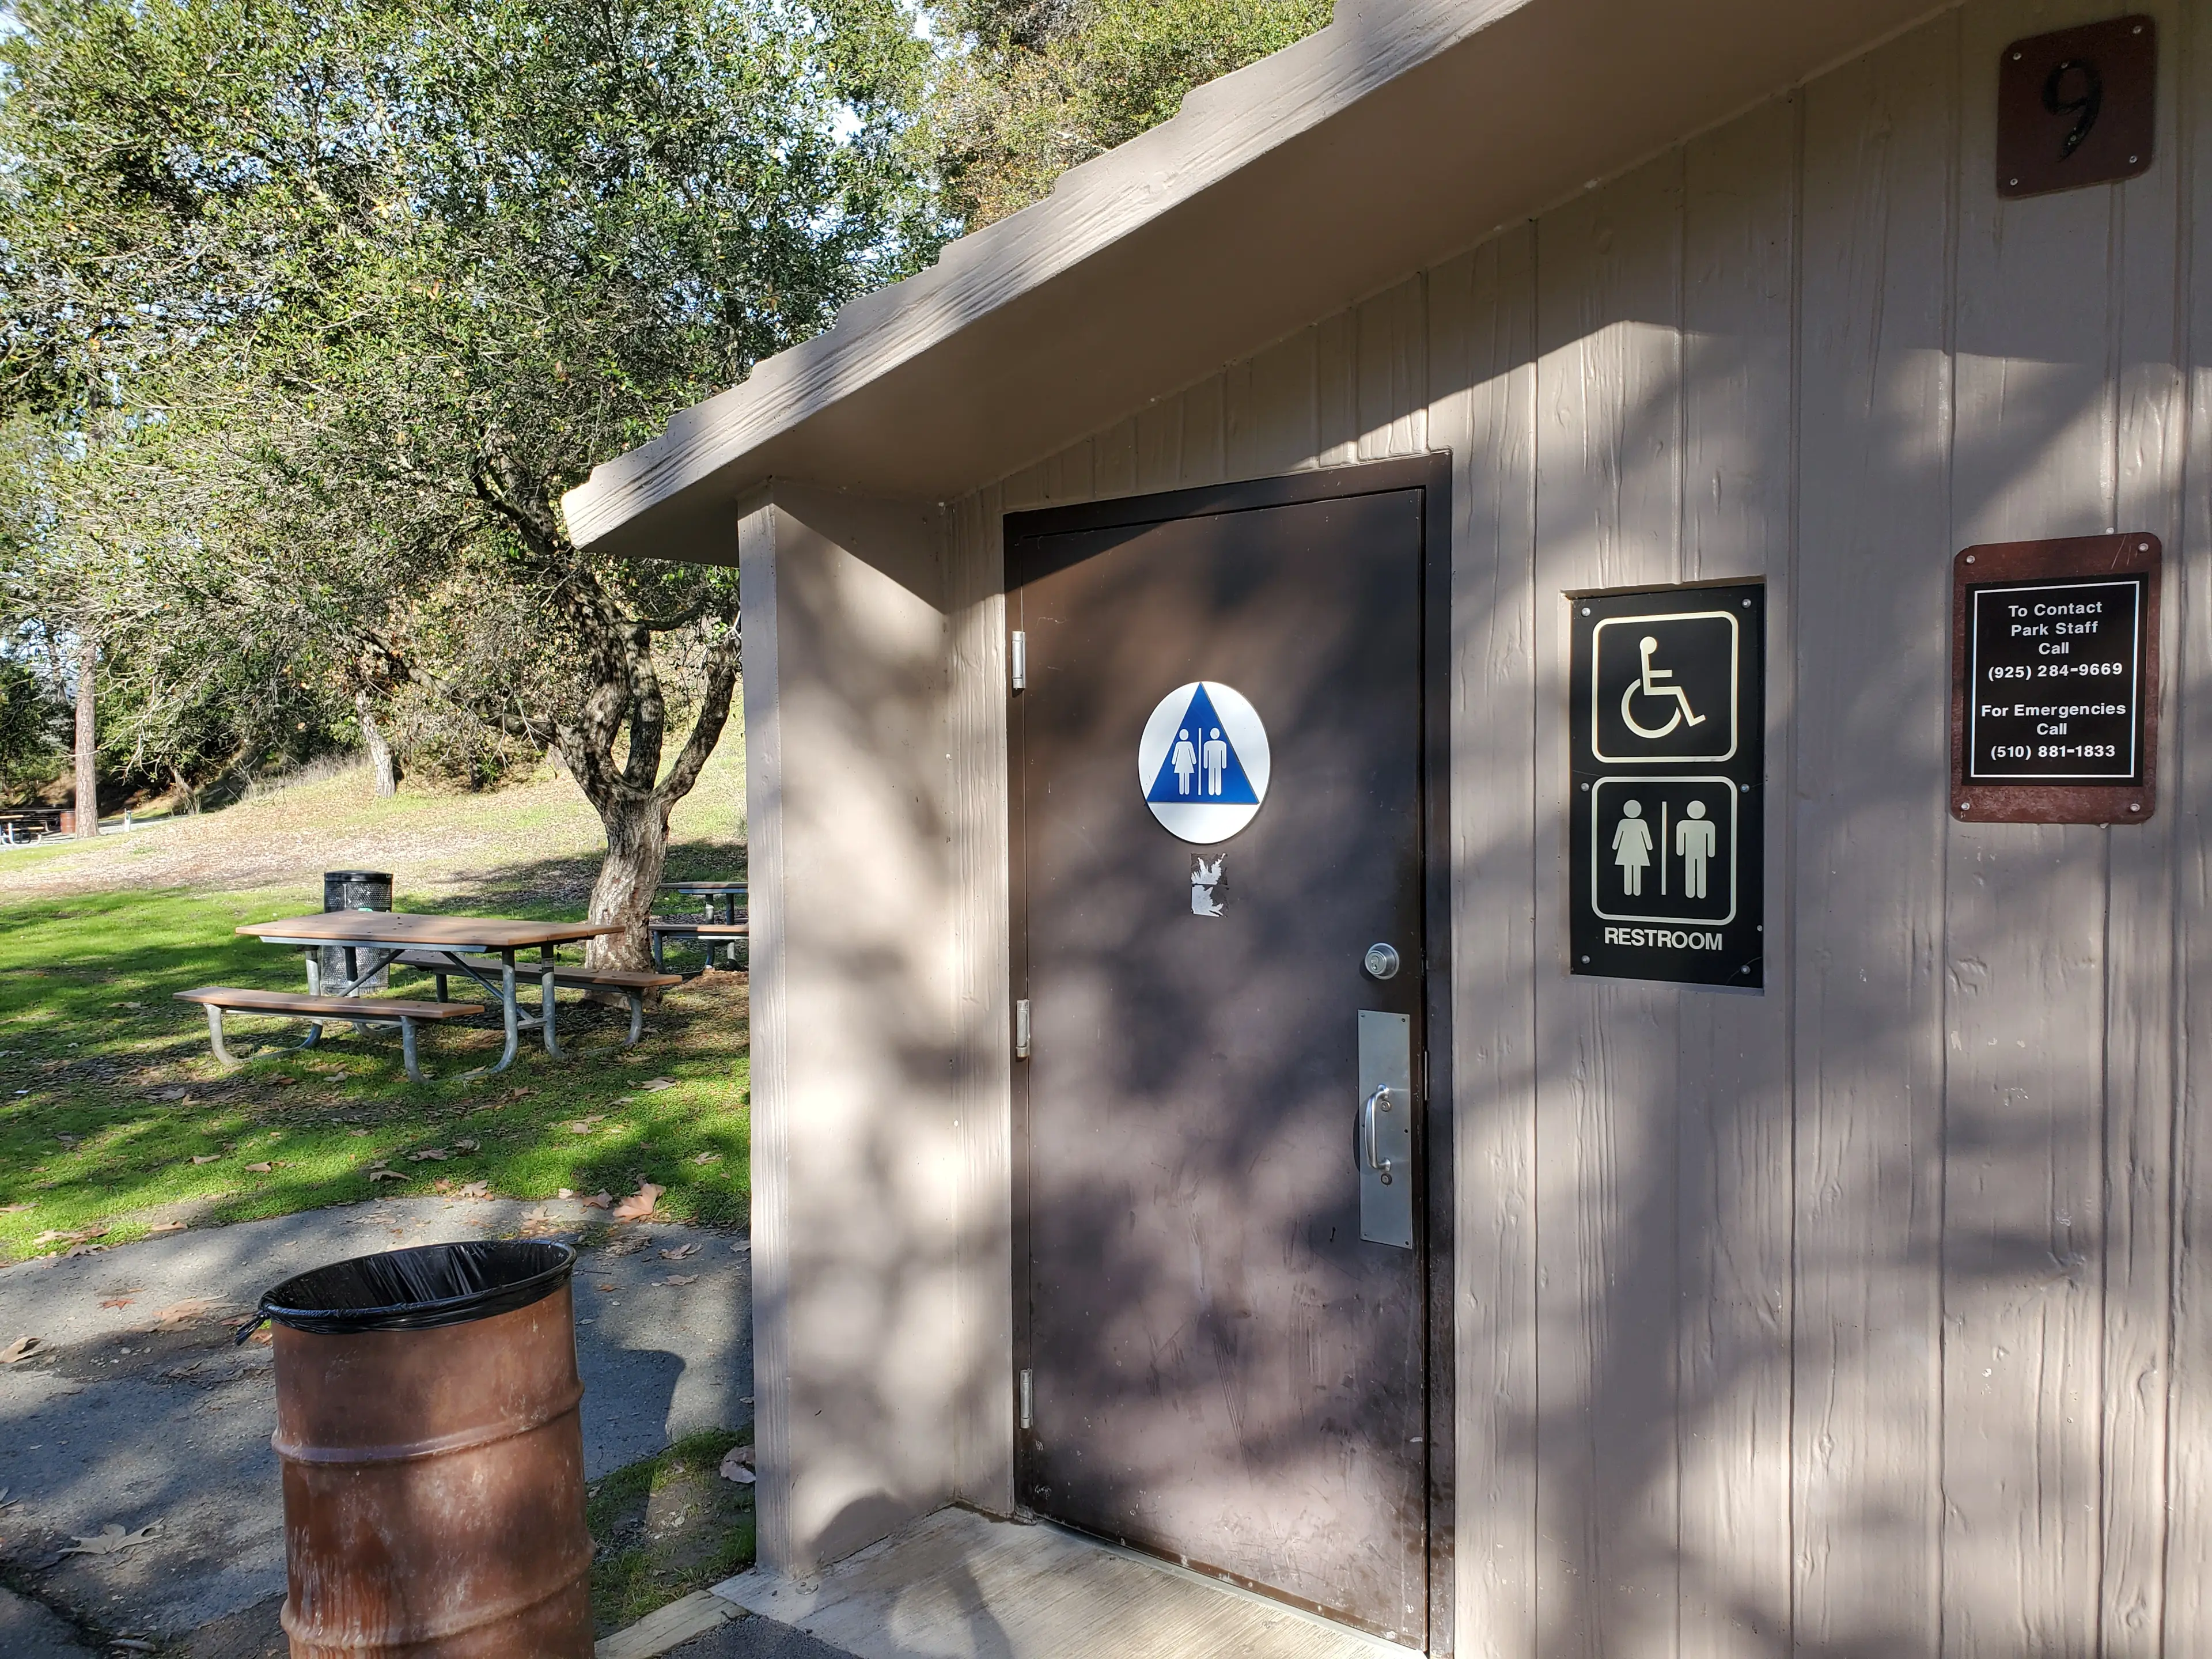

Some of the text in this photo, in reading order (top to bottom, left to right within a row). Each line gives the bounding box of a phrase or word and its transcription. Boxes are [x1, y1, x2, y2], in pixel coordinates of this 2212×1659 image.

[2043, 59, 2102, 162] 9
[2008, 601, 2103, 618] To Contact
[2011, 620, 2099, 637] Park Staff
[2038, 642, 2069, 655] Call
[1988, 662, 2123, 681] (925) 284-9669
[1981, 702, 2126, 719] For Emergencies
[2036, 722, 2067, 736] Call
[1991, 745, 2115, 760] (510) 881-1833
[1604, 927, 1723, 950] RESTROOM
